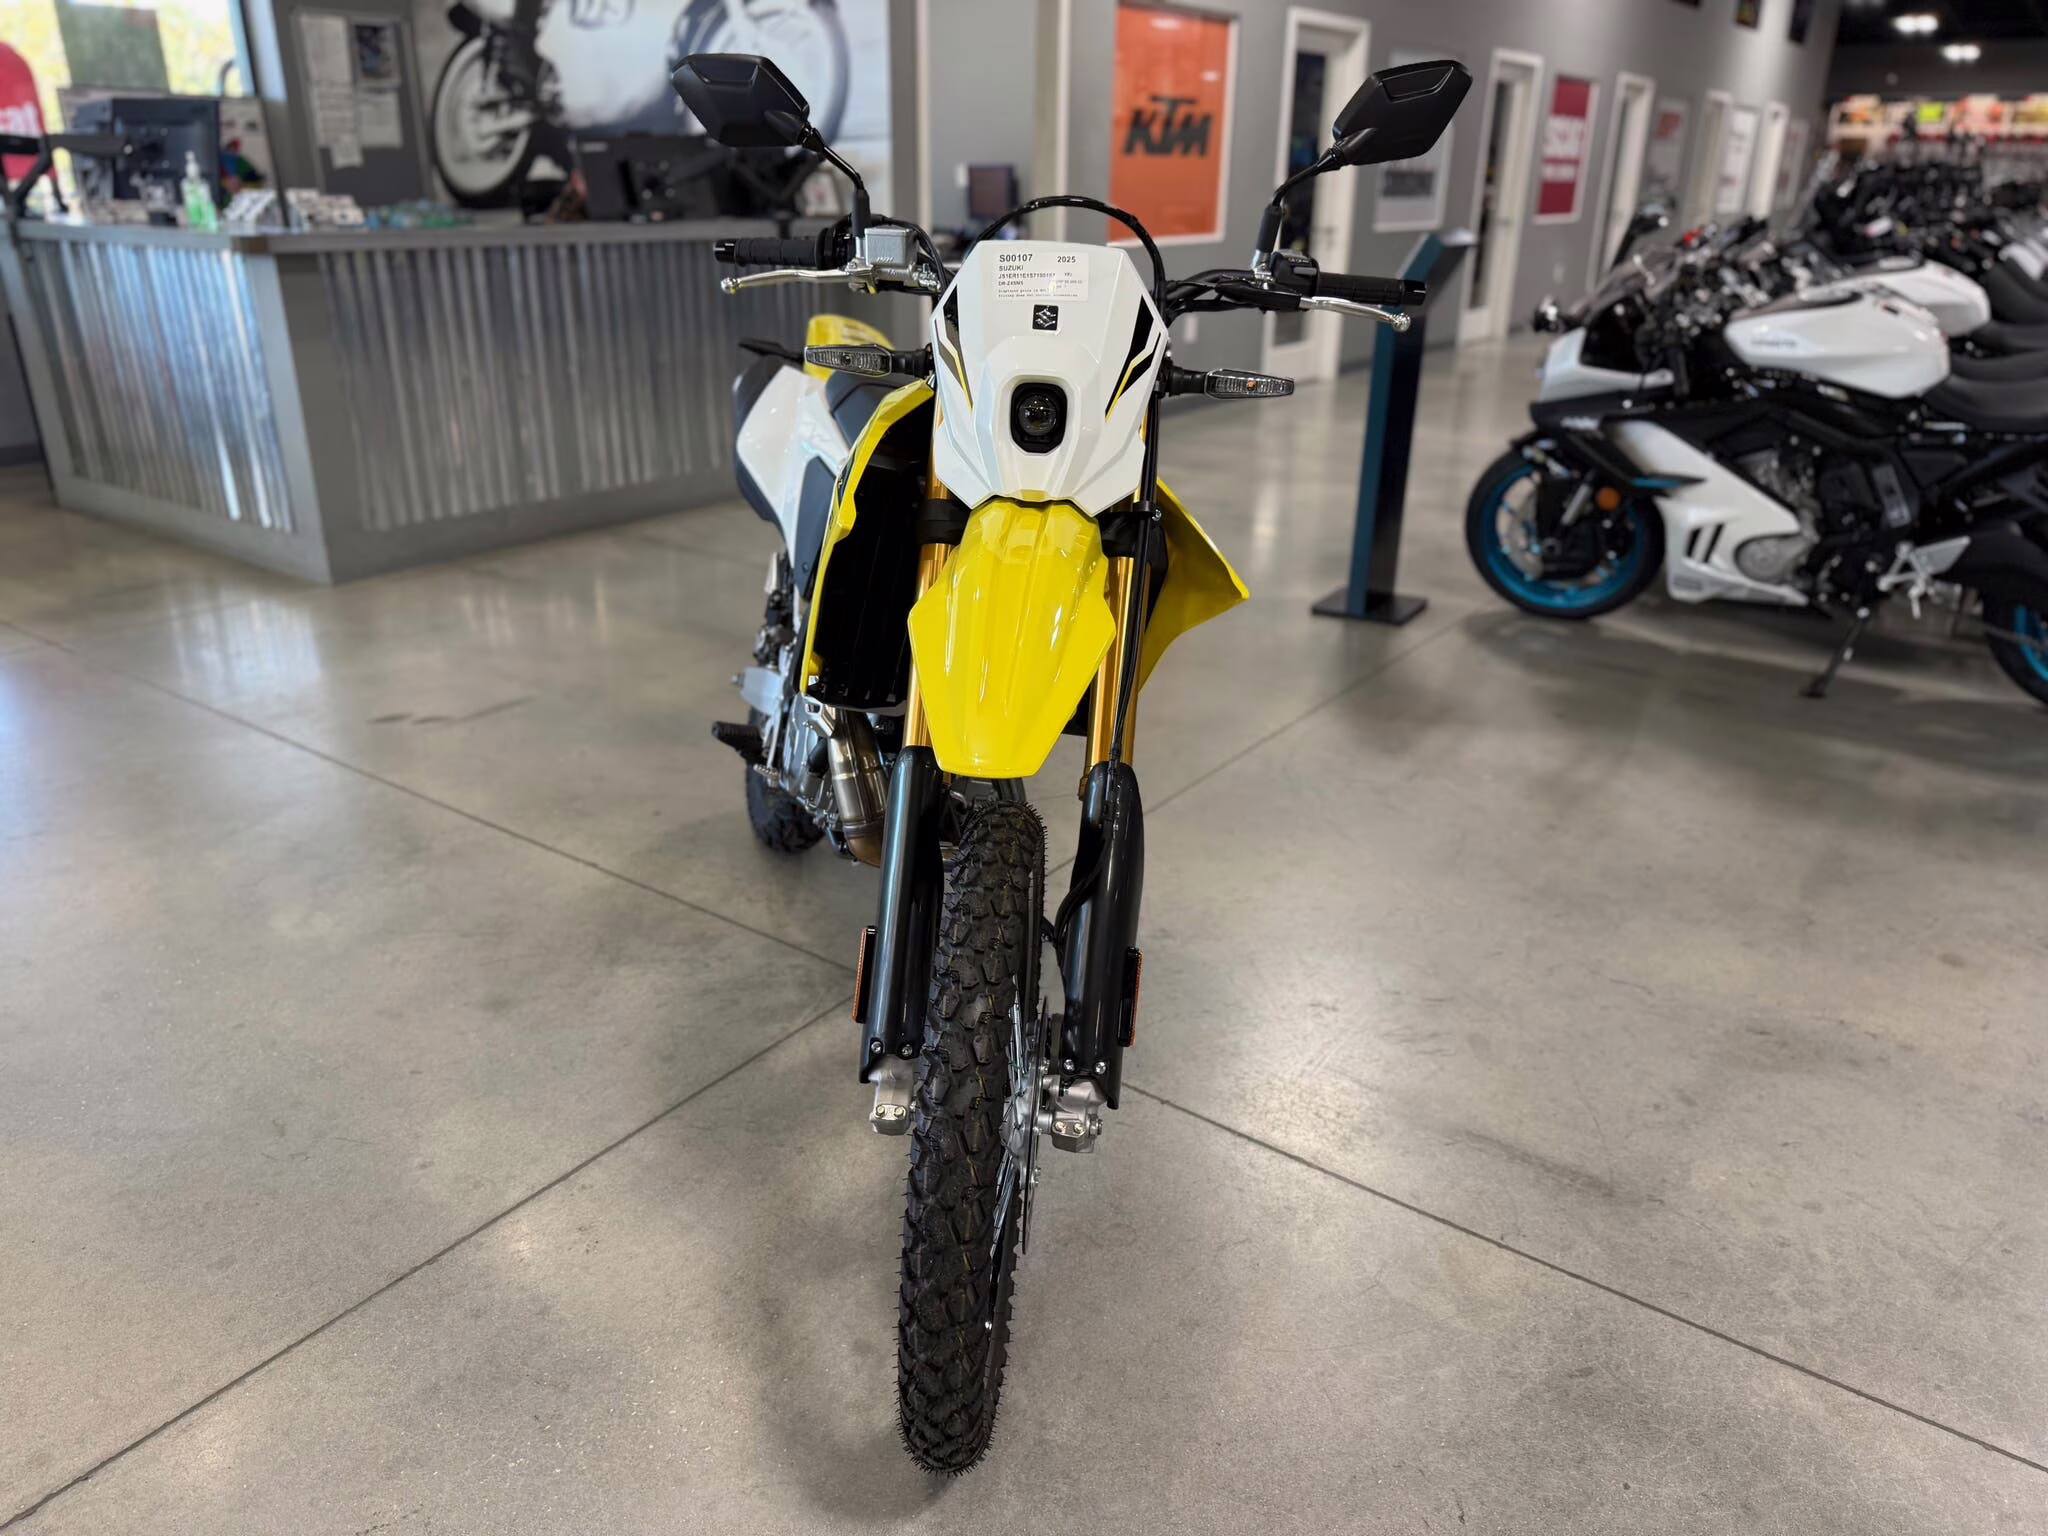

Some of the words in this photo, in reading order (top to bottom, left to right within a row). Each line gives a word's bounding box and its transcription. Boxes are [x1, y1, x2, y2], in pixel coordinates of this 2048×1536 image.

[1124, 95, 1213, 157] KTM
[999, 253, 1033, 263] S00107
[1057, 255, 1076, 263] 2025
